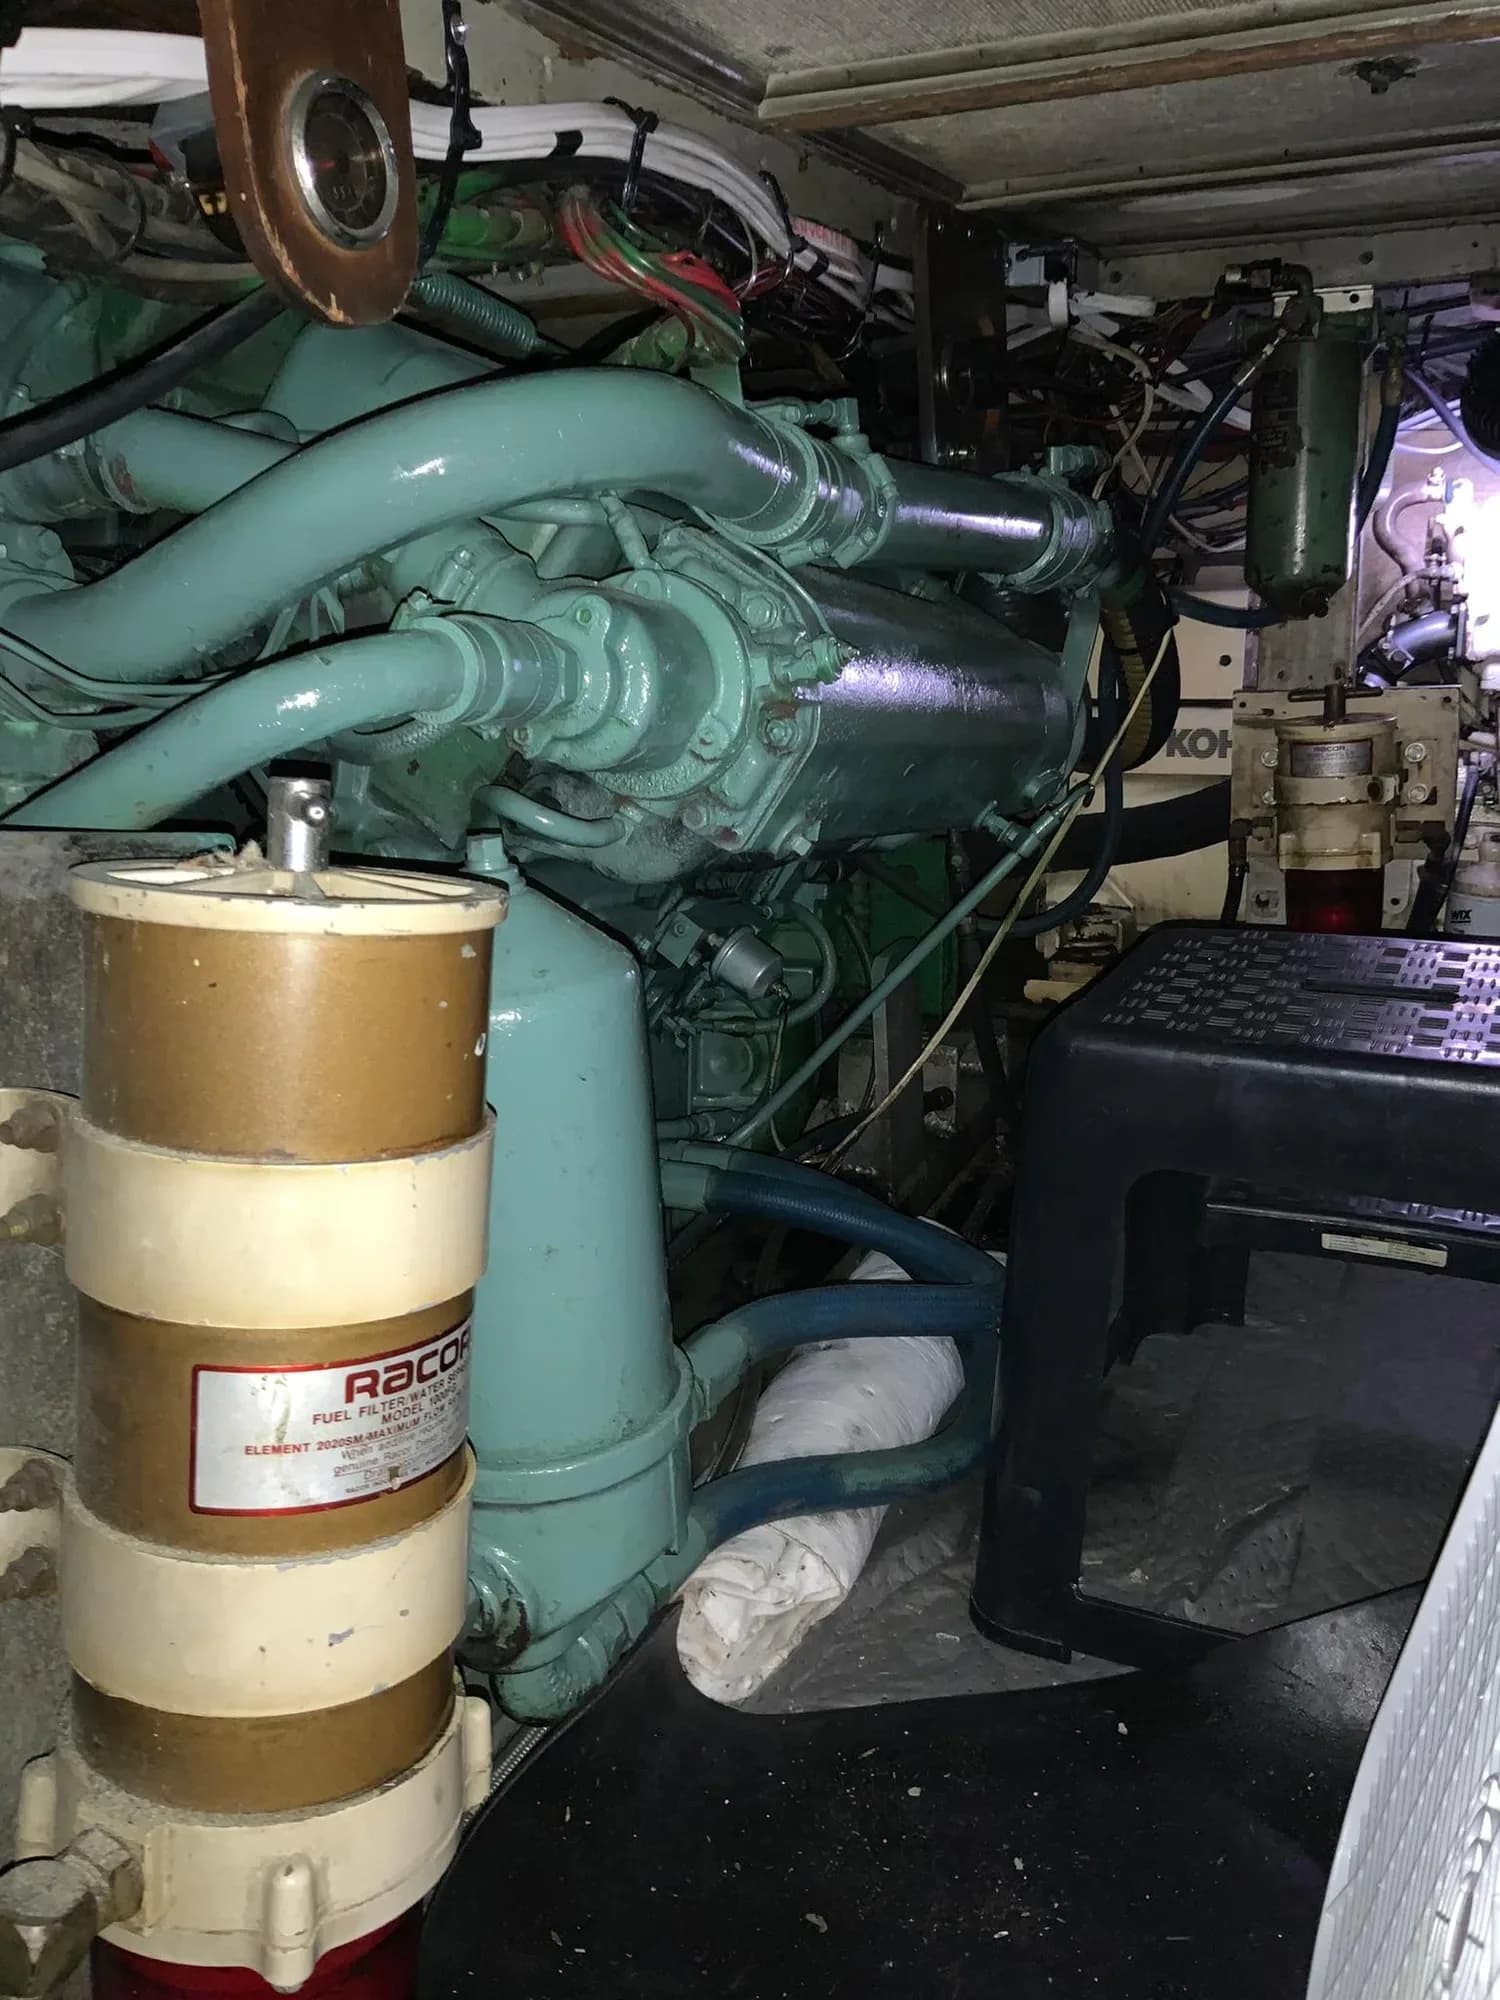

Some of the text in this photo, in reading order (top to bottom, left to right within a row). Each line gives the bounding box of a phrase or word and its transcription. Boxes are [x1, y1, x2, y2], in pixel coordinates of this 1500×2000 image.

[311, 1410, 352, 1425] FUEL
[381, 1402, 424, 1425] MODEL
[244, 1442, 311, 1456] ELEMENT
